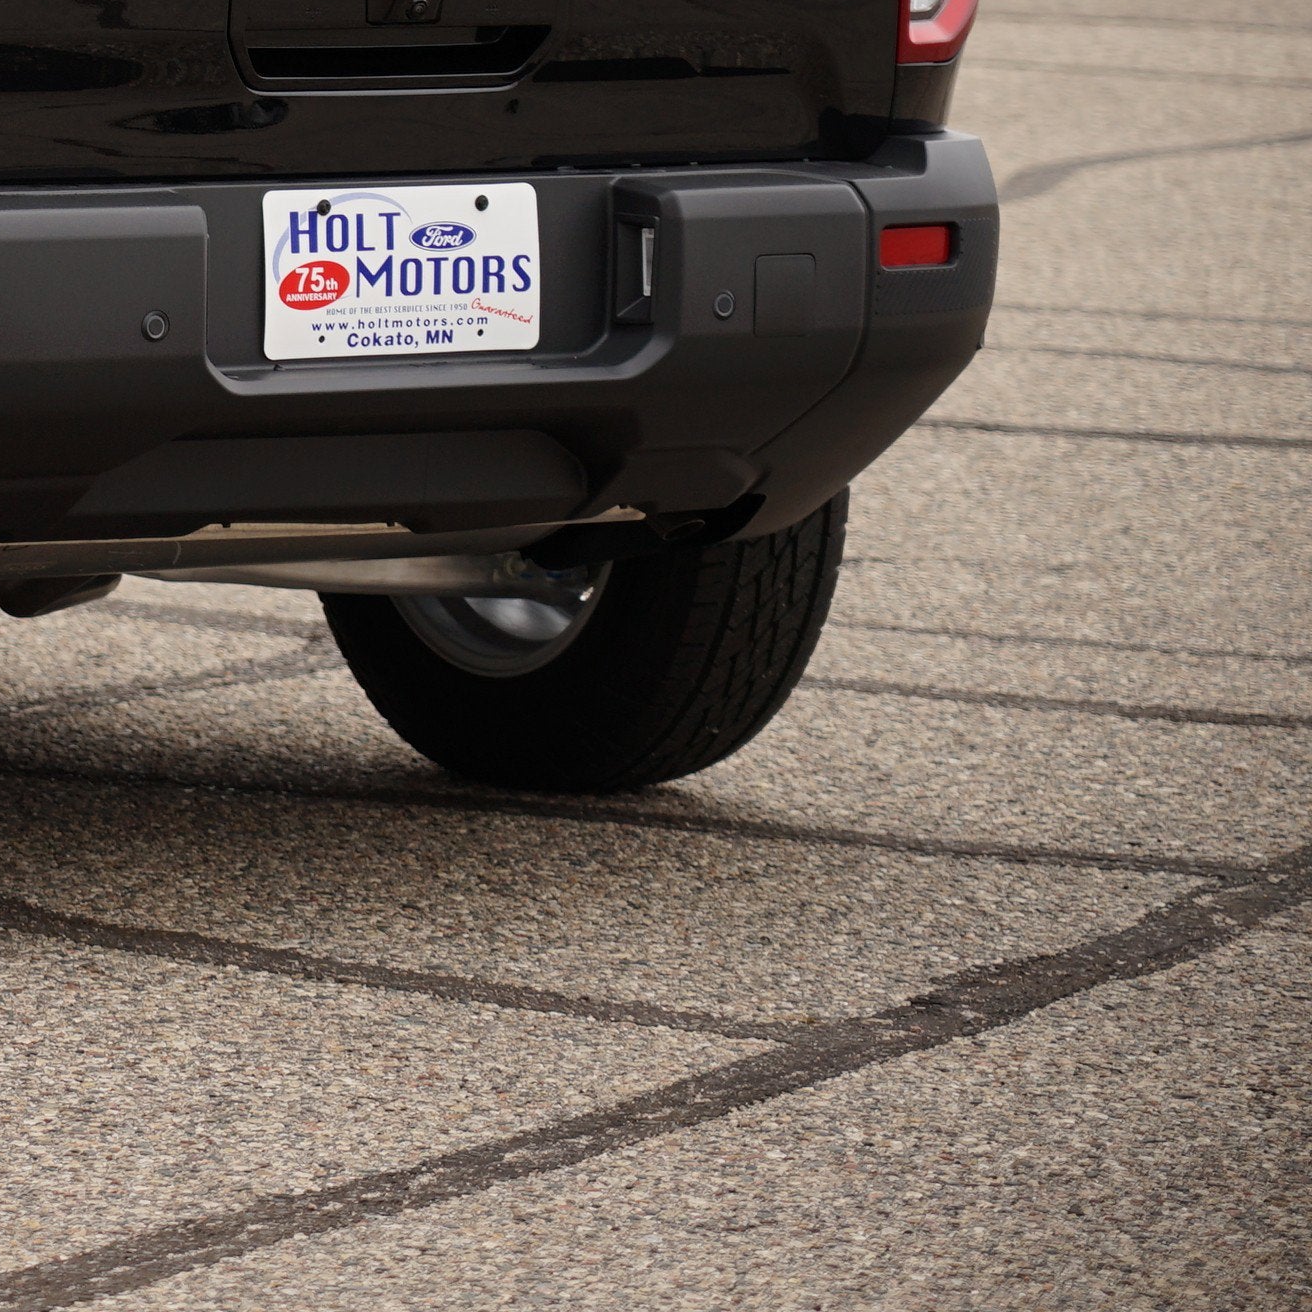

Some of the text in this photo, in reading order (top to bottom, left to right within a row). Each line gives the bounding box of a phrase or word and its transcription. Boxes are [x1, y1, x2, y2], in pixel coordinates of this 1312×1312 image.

[289, 211, 401, 254] HOLT
[421, 225, 464, 248] Ford
[295, 266, 339, 294] 75th
[356, 255, 532, 299] MOTORS
[285, 292, 338, 303] ANNIVERSARY
[326, 308, 346, 316] HOME
[360, 307, 372, 315] THE
[375, 306, 392, 314] BEST
[394, 304, 423, 313] SERVICE
[425, 304, 447, 312] SINCE
[450, 303, 468, 311] 1950
[471, 297, 534, 325] Guaranteed
[311, 316, 488, 331] www.holtmotors.com
[347, 329, 454, 348] Cokato, MN
